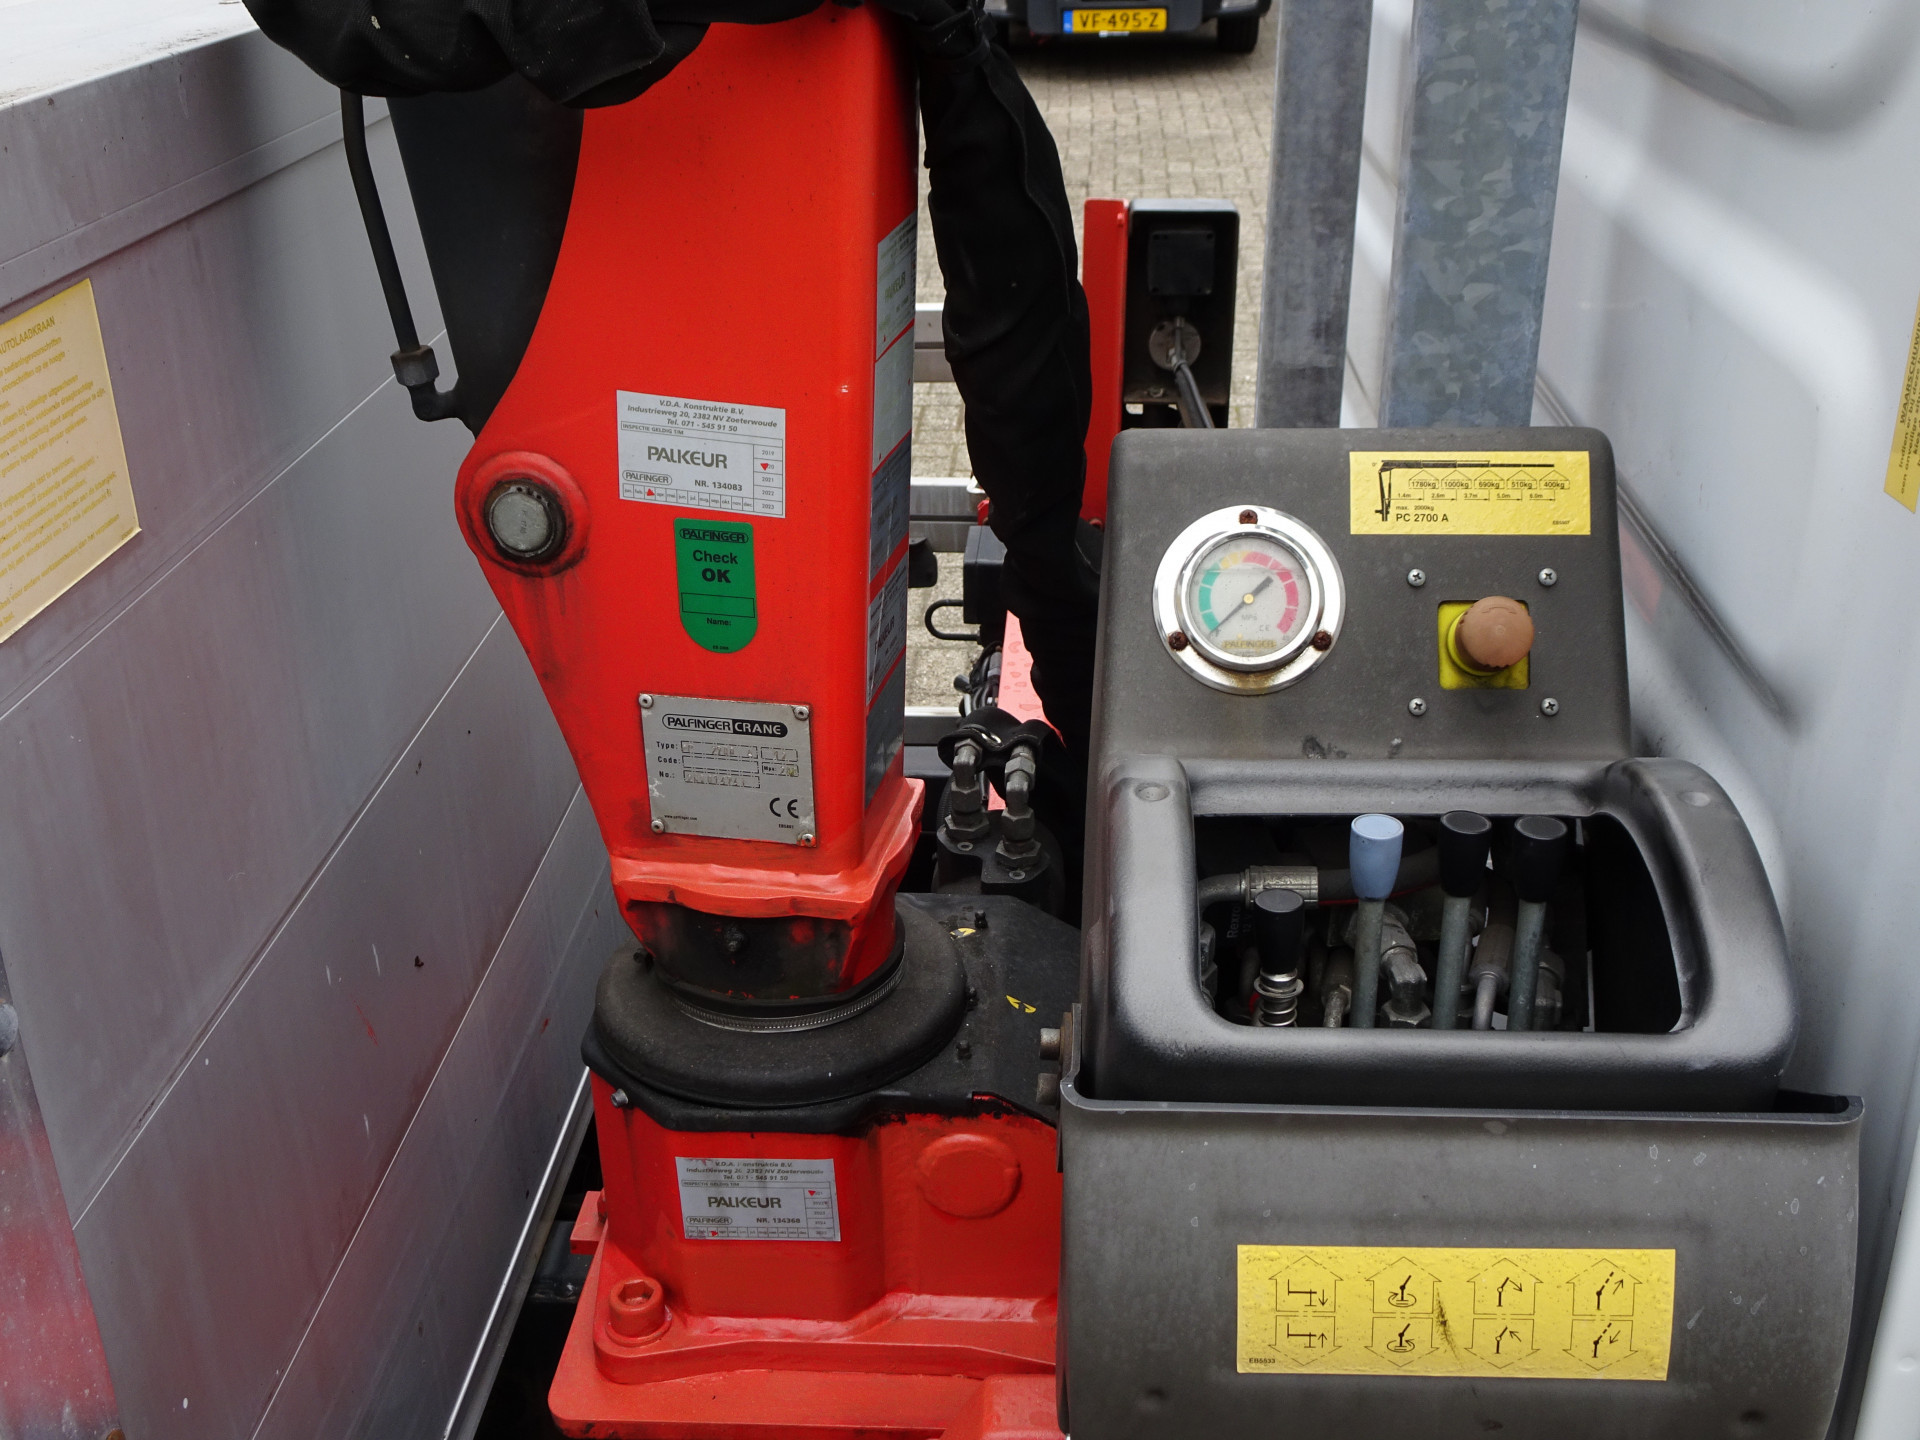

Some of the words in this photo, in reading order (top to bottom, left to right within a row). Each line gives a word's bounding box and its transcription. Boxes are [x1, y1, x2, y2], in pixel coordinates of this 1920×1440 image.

[1080, 12, 1158, 28] VF-495-Z
[659, 400, 680, 409] V.D.A.
[684, 403, 728, 413] Konstruktie
[627, 405, 677, 418] Industrieweg
[726, 417, 777, 427] Zoeterwoude
[647, 445, 728, 469] PALKEUR
[625, 472, 669, 483] PALFINGER
[712, 482, 743, 492] 134083
[1412, 481, 1436, 489] 1780kg
[1444, 481, 1469, 489] 1000kg
[1478, 481, 1500, 489] 690kg
[1511, 481, 1533, 489] 510kg
[1544, 481, 1565, 489] 400kg
[1396, 514, 1411, 522] PC
[1414, 514, 1438, 522] 2700
[1441, 514, 1449, 522] A
[682, 529, 745, 542] PALFINGER
[692, 549, 738, 564] Check
[701, 568, 731, 583] OK
[707, 617, 731, 626] Name:
[667, 716, 731, 731] PALFINGER
[735, 722, 781, 734] CRANE
[656, 741, 678, 750] Type:
[658, 756, 680, 764] Code:
[708, 1197, 782, 1208] PALKEUR
